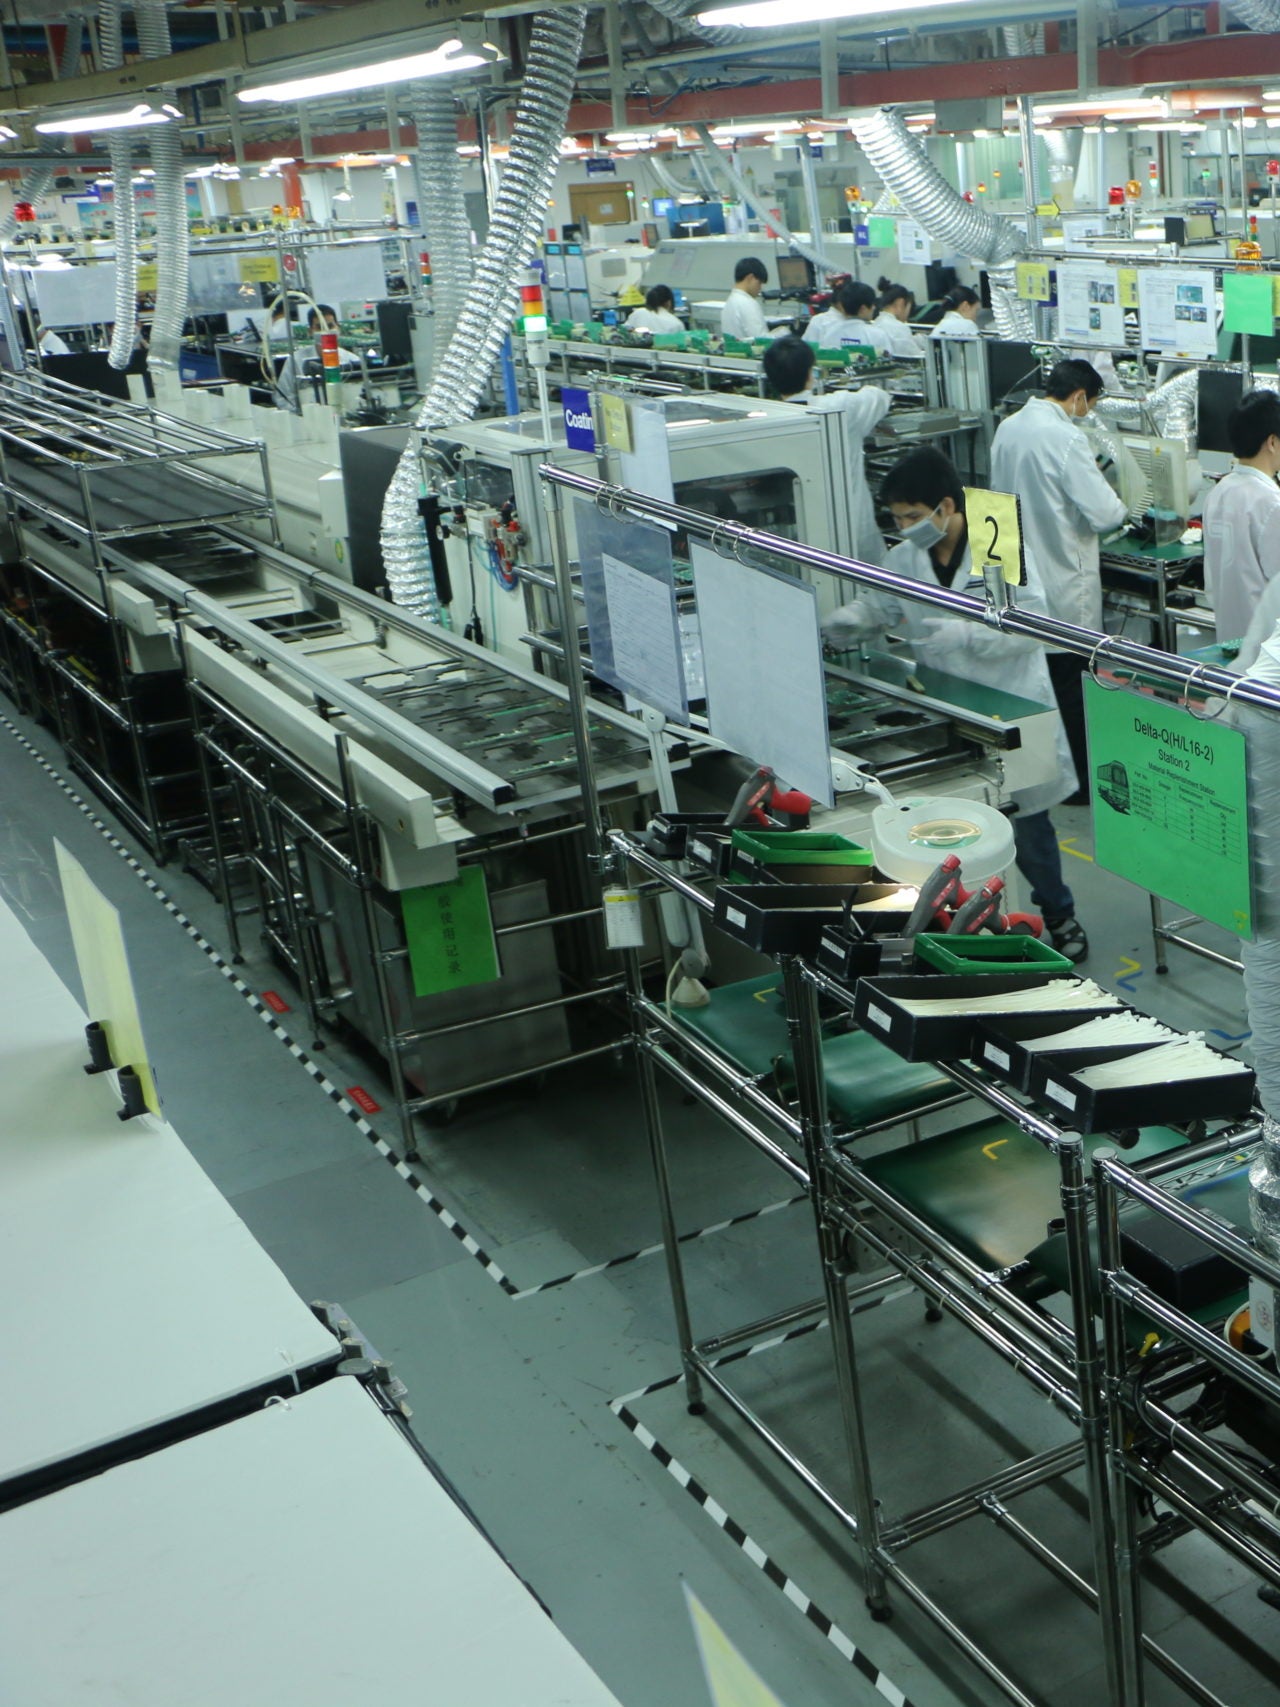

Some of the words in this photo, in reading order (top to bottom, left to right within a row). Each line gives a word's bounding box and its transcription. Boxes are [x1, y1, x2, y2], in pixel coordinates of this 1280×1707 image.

[565, 408, 594, 430] Coatin
[984, 515, 1002, 561] 2
[1158, 749, 1184, 769] Station
[1184, 761, 1190, 772] 2
